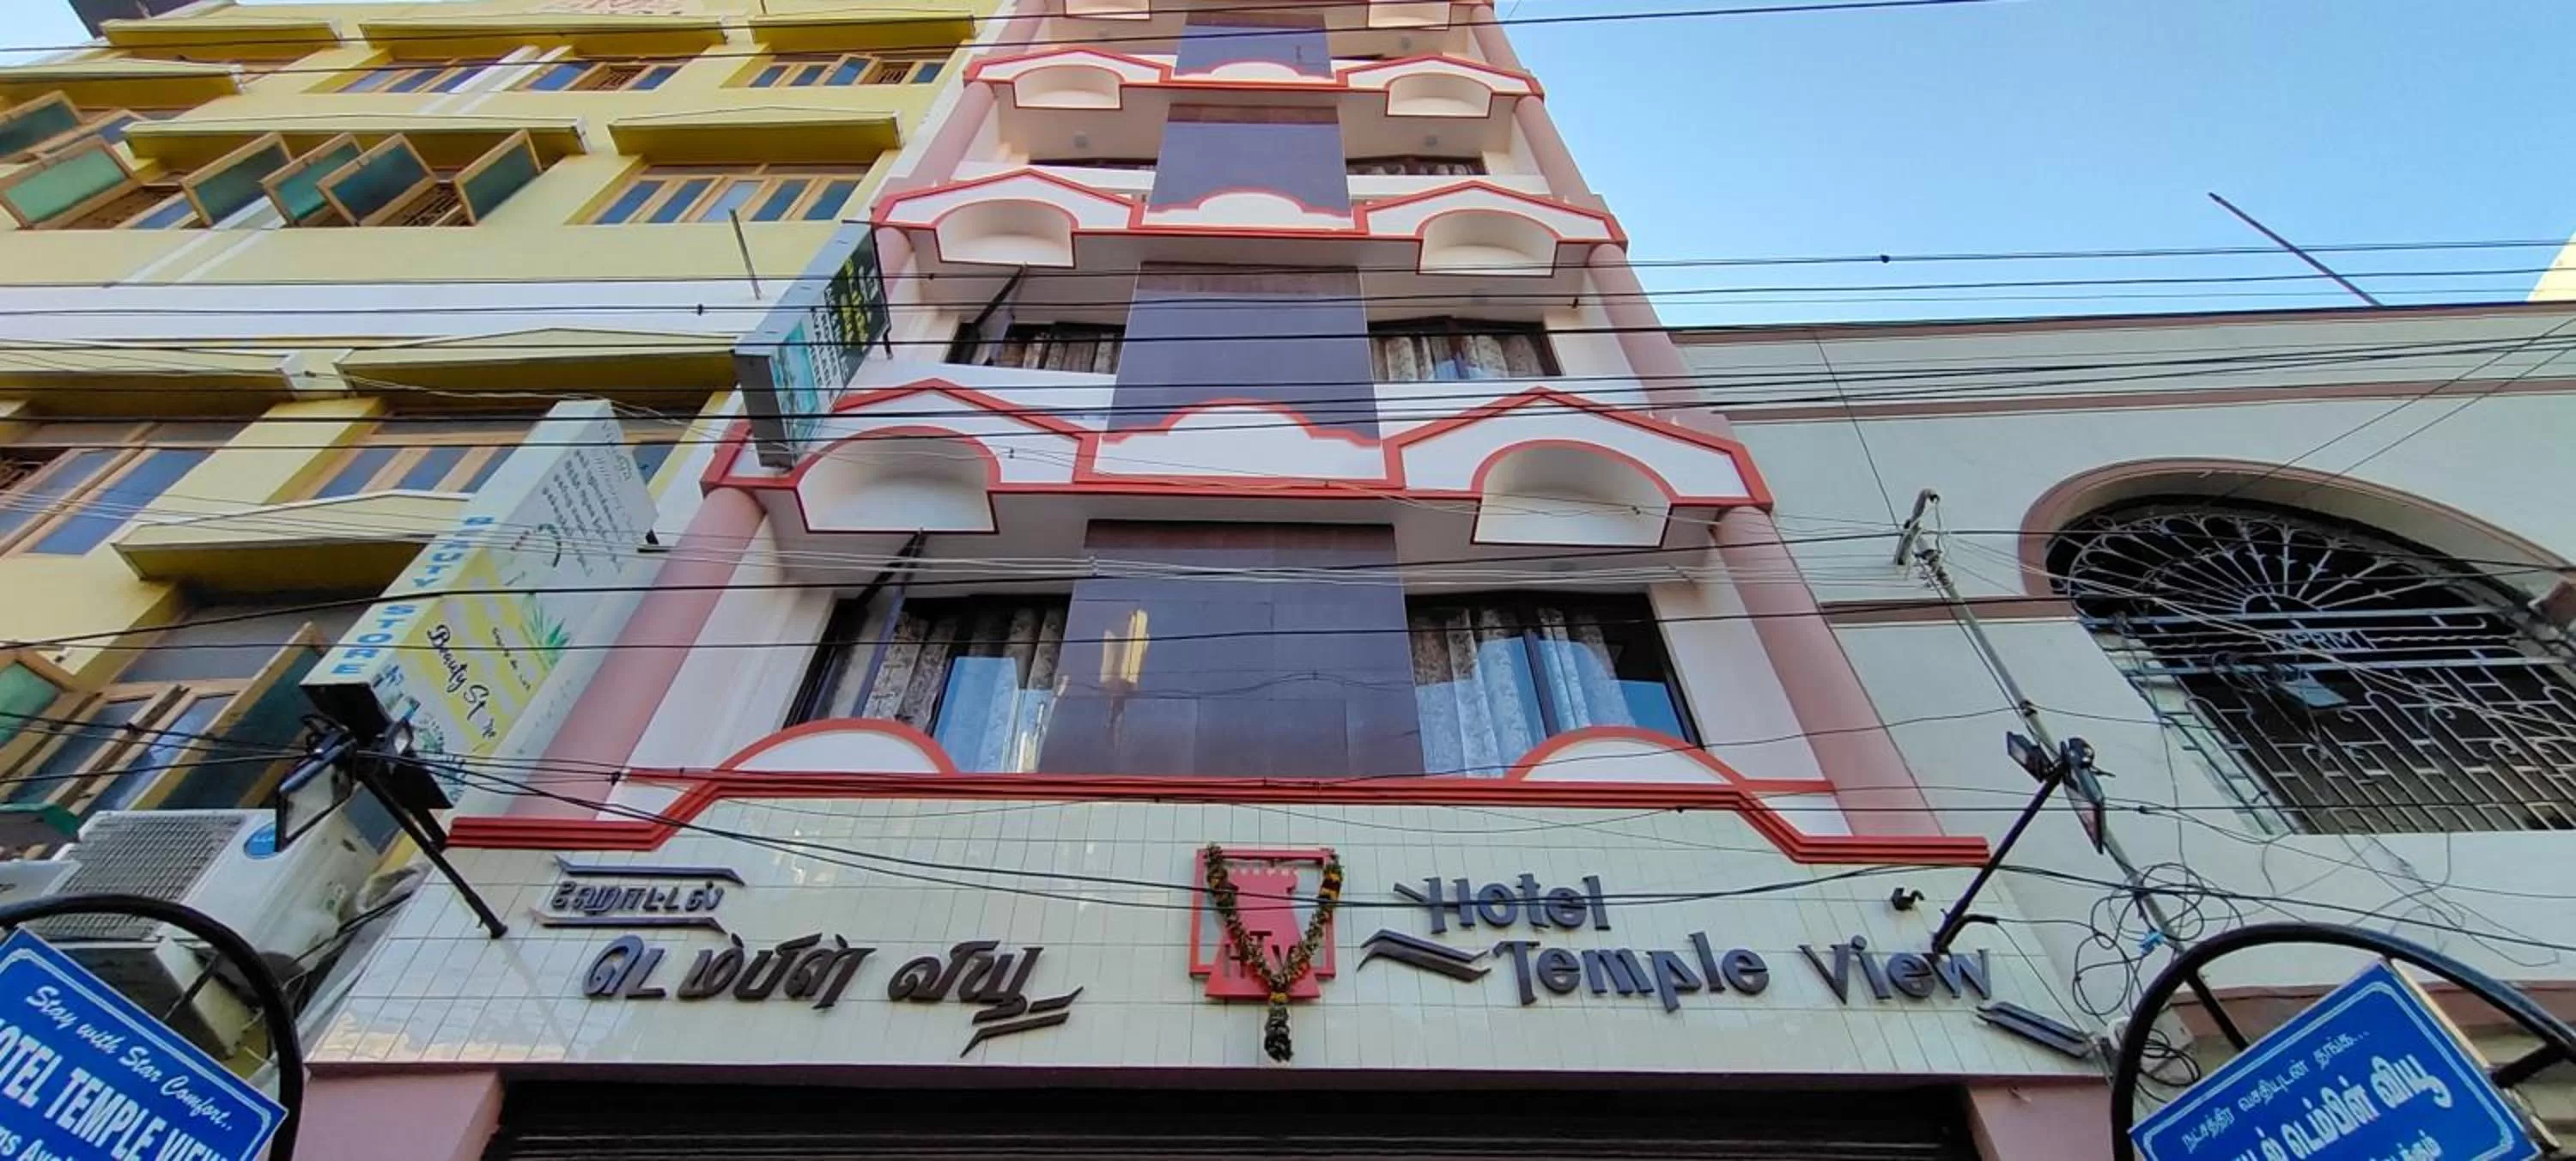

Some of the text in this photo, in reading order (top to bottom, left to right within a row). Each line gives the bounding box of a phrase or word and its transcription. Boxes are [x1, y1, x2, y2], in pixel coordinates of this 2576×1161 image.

[331, 605, 416, 674] STORE
[427, 624, 468, 693] Beauty
[1393, 872, 1611, 934] Hotel
[1493, 931, 1991, 1013] Temple View
[25, 985, 78, 1030] Stay
[76, 1023, 126, 1055] with
[118, 1045, 163, 1083] Star
[0, 1018, 63, 1109] OTEL
[44, 1067, 167, 1161] TEMPLE
